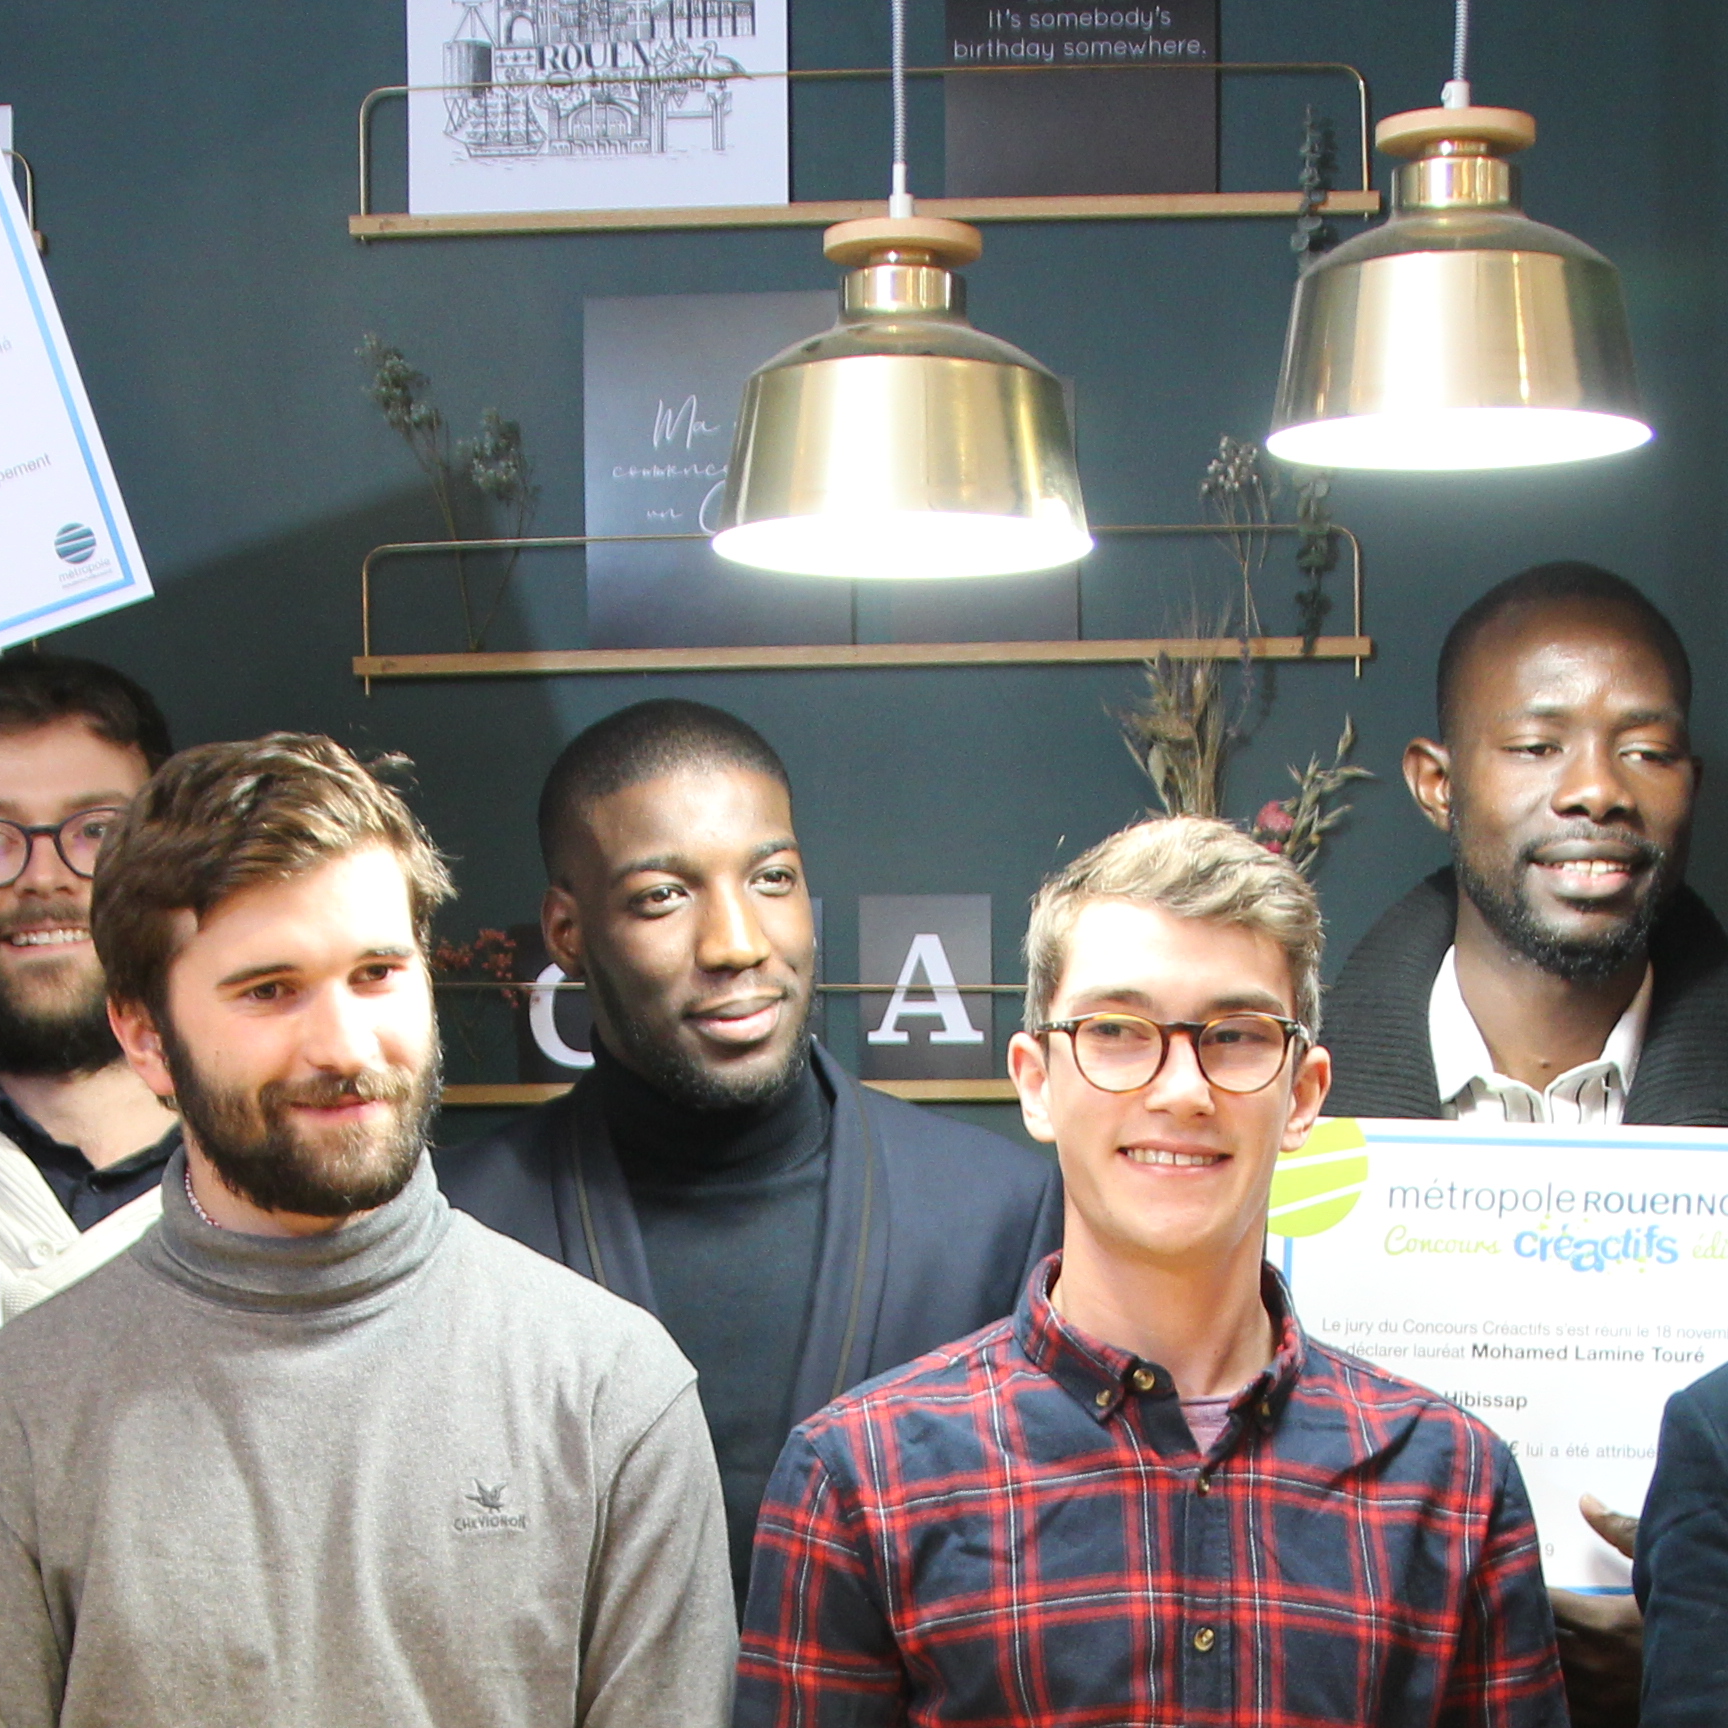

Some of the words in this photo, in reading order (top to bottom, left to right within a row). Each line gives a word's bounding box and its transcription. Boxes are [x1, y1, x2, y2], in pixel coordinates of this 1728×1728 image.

[988, 8, 1022, 29] It's
[1029, 5, 1172, 31] somebody's
[538, 38, 652, 71] ROUEN
[953, 37, 1055, 63] birthday
[1063, 34, 1207, 58] somewhere.
[867, 932, 985, 1045] A
[1388, 1180, 1576, 1220] métropole
[1382, 1223, 1501, 1257] Concours
[1322, 1318, 1341, 1332] Le
[1344, 1318, 1373, 1338] jury
[1376, 1317, 1399, 1335] du
[1401, 1317, 1479, 1336] Concours
[1481, 1318, 1551, 1337] Créactifs
[1555, 1323, 1590, 1338] s'est
[1593, 1325, 1632, 1337] réuni
[1635, 1323, 1651, 1338] le
[1655, 1324, 1672, 1339] 18
[1413, 1345, 1464, 1358] lauréat
[1471, 1341, 1568, 1360] Mohamed
[1574, 1345, 1644, 1362] Lamine
[1652, 1345, 1705, 1363] Touré
